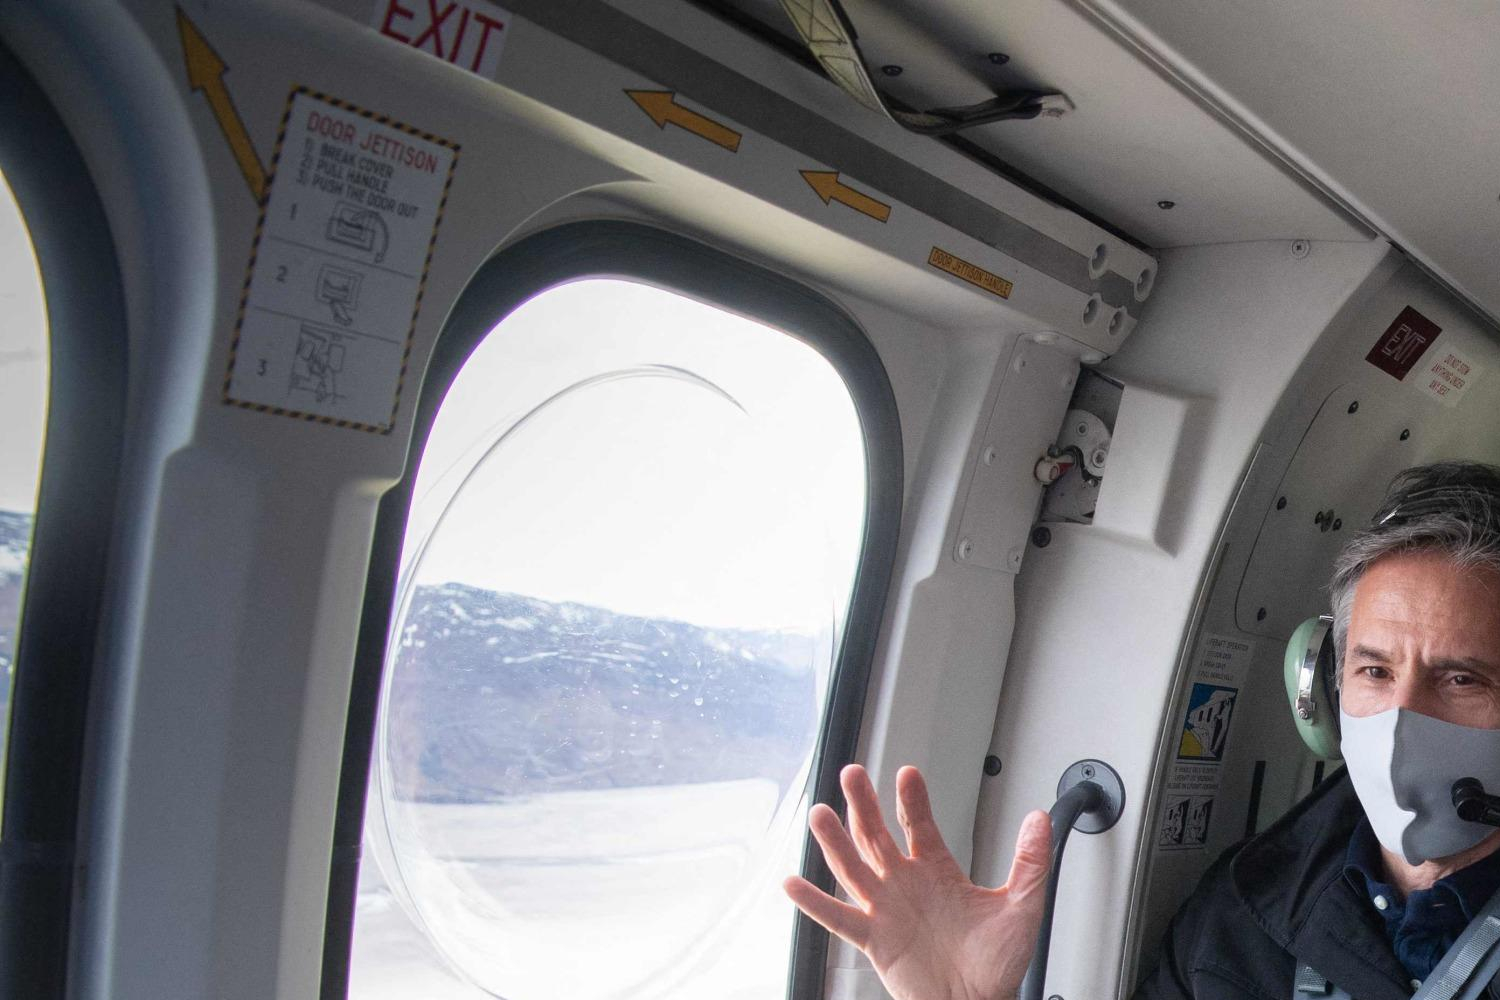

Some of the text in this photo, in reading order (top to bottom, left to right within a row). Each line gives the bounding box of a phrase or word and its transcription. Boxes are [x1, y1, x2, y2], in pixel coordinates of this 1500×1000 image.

[380, 0, 504, 73] EXIT
[306, 110, 438, 174] DOOR JETTISON
[315, 159, 344, 180] PULL
[346, 168, 389, 194] HANDLE
[358, 156, 394, 179] COVER
[290, 203, 297, 220] 1
[311, 176, 344, 195] PUSH
[346, 186, 366, 202] THE
[367, 191, 397, 211] DOOR
[397, 203, 420, 218] OUT
[276, 265, 288, 283] 2
[932, 250, 953, 266] DOOR
[952, 262, 984, 281] JETTISON
[1381, 323, 1426, 365] EXIT
[256, 361, 267, 376] 3
